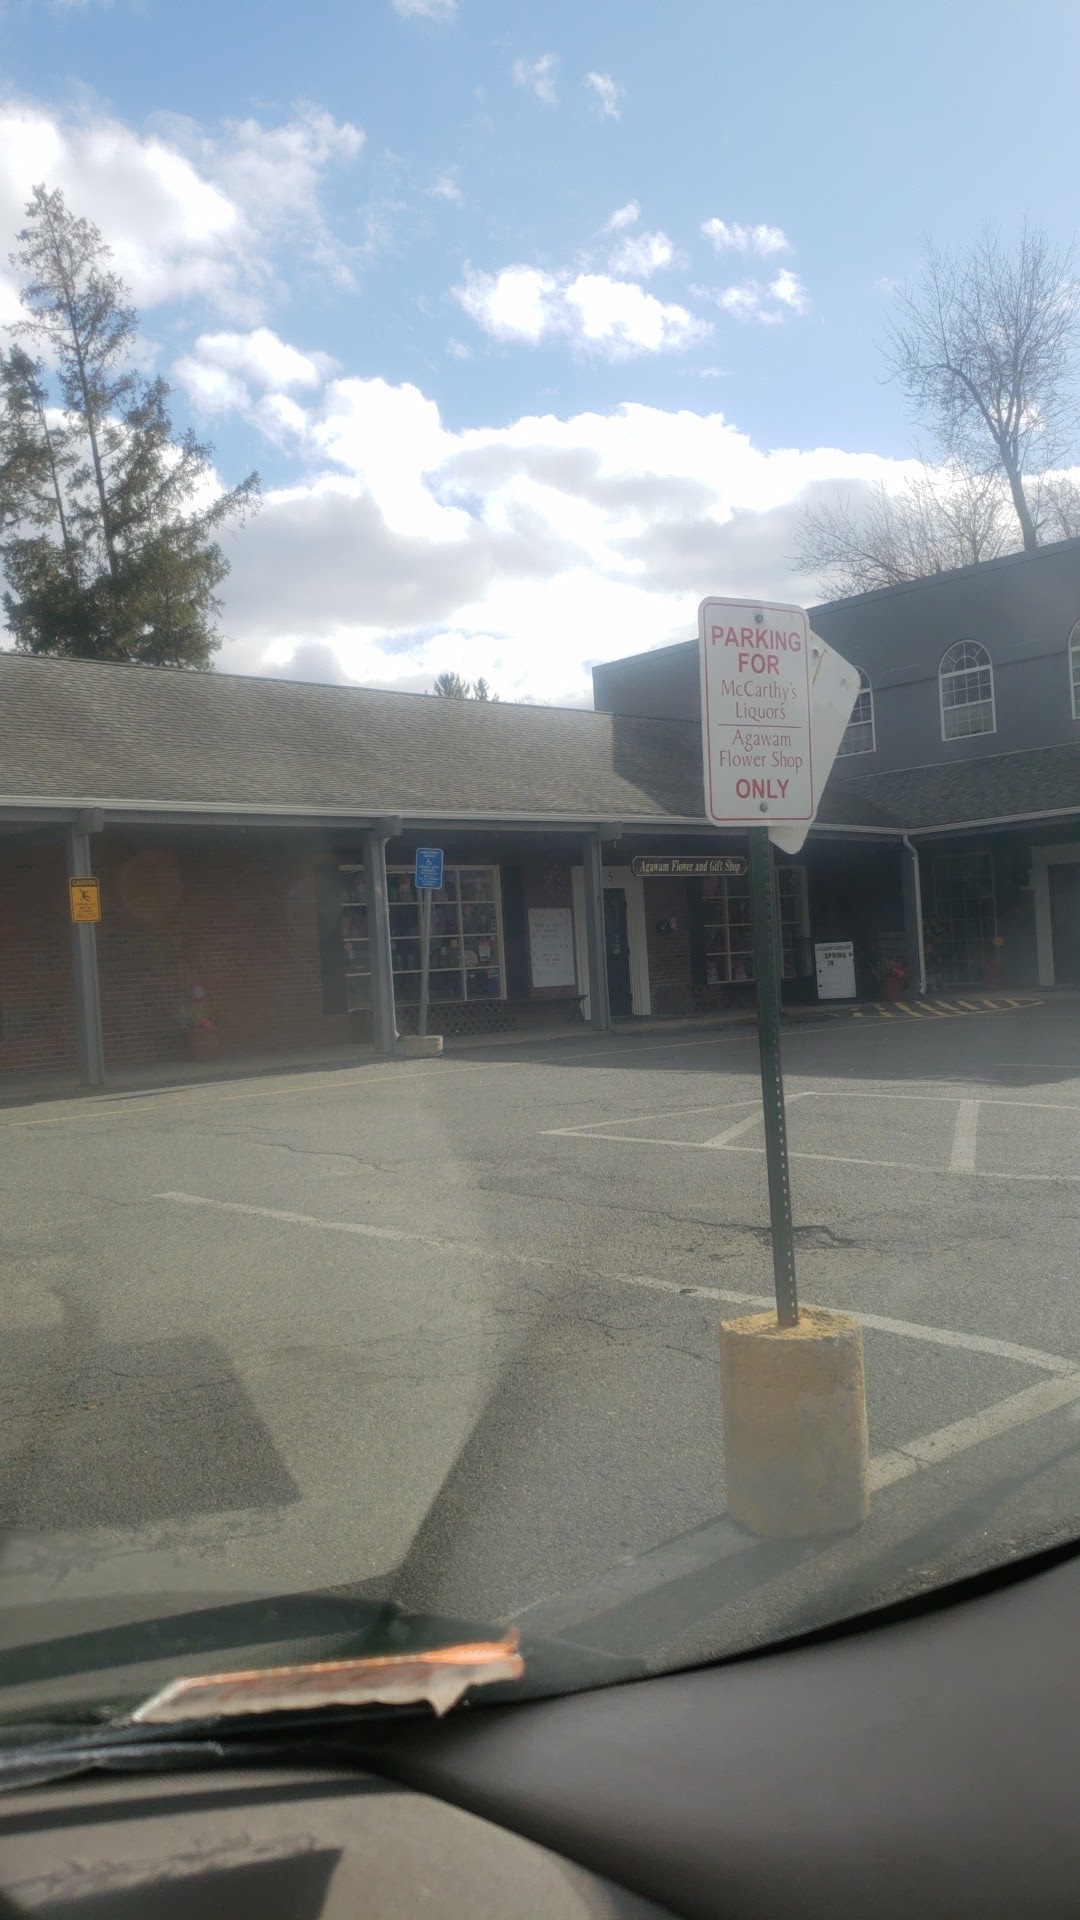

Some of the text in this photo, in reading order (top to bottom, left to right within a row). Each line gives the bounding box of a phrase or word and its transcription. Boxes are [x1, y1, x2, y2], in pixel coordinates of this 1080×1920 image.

[711, 625, 801, 652] PARKING
[738, 652, 780, 675] FOR
[721, 680, 797, 705] McCarthy's
[735, 702, 786, 721] Liquors
[732, 729, 791, 752] Agawam
[720, 750, 803, 773] Flower Shop
[736, 779, 789, 798] ONLY
[640, 860, 741, 874] Agawam Flower and Gift Shop
